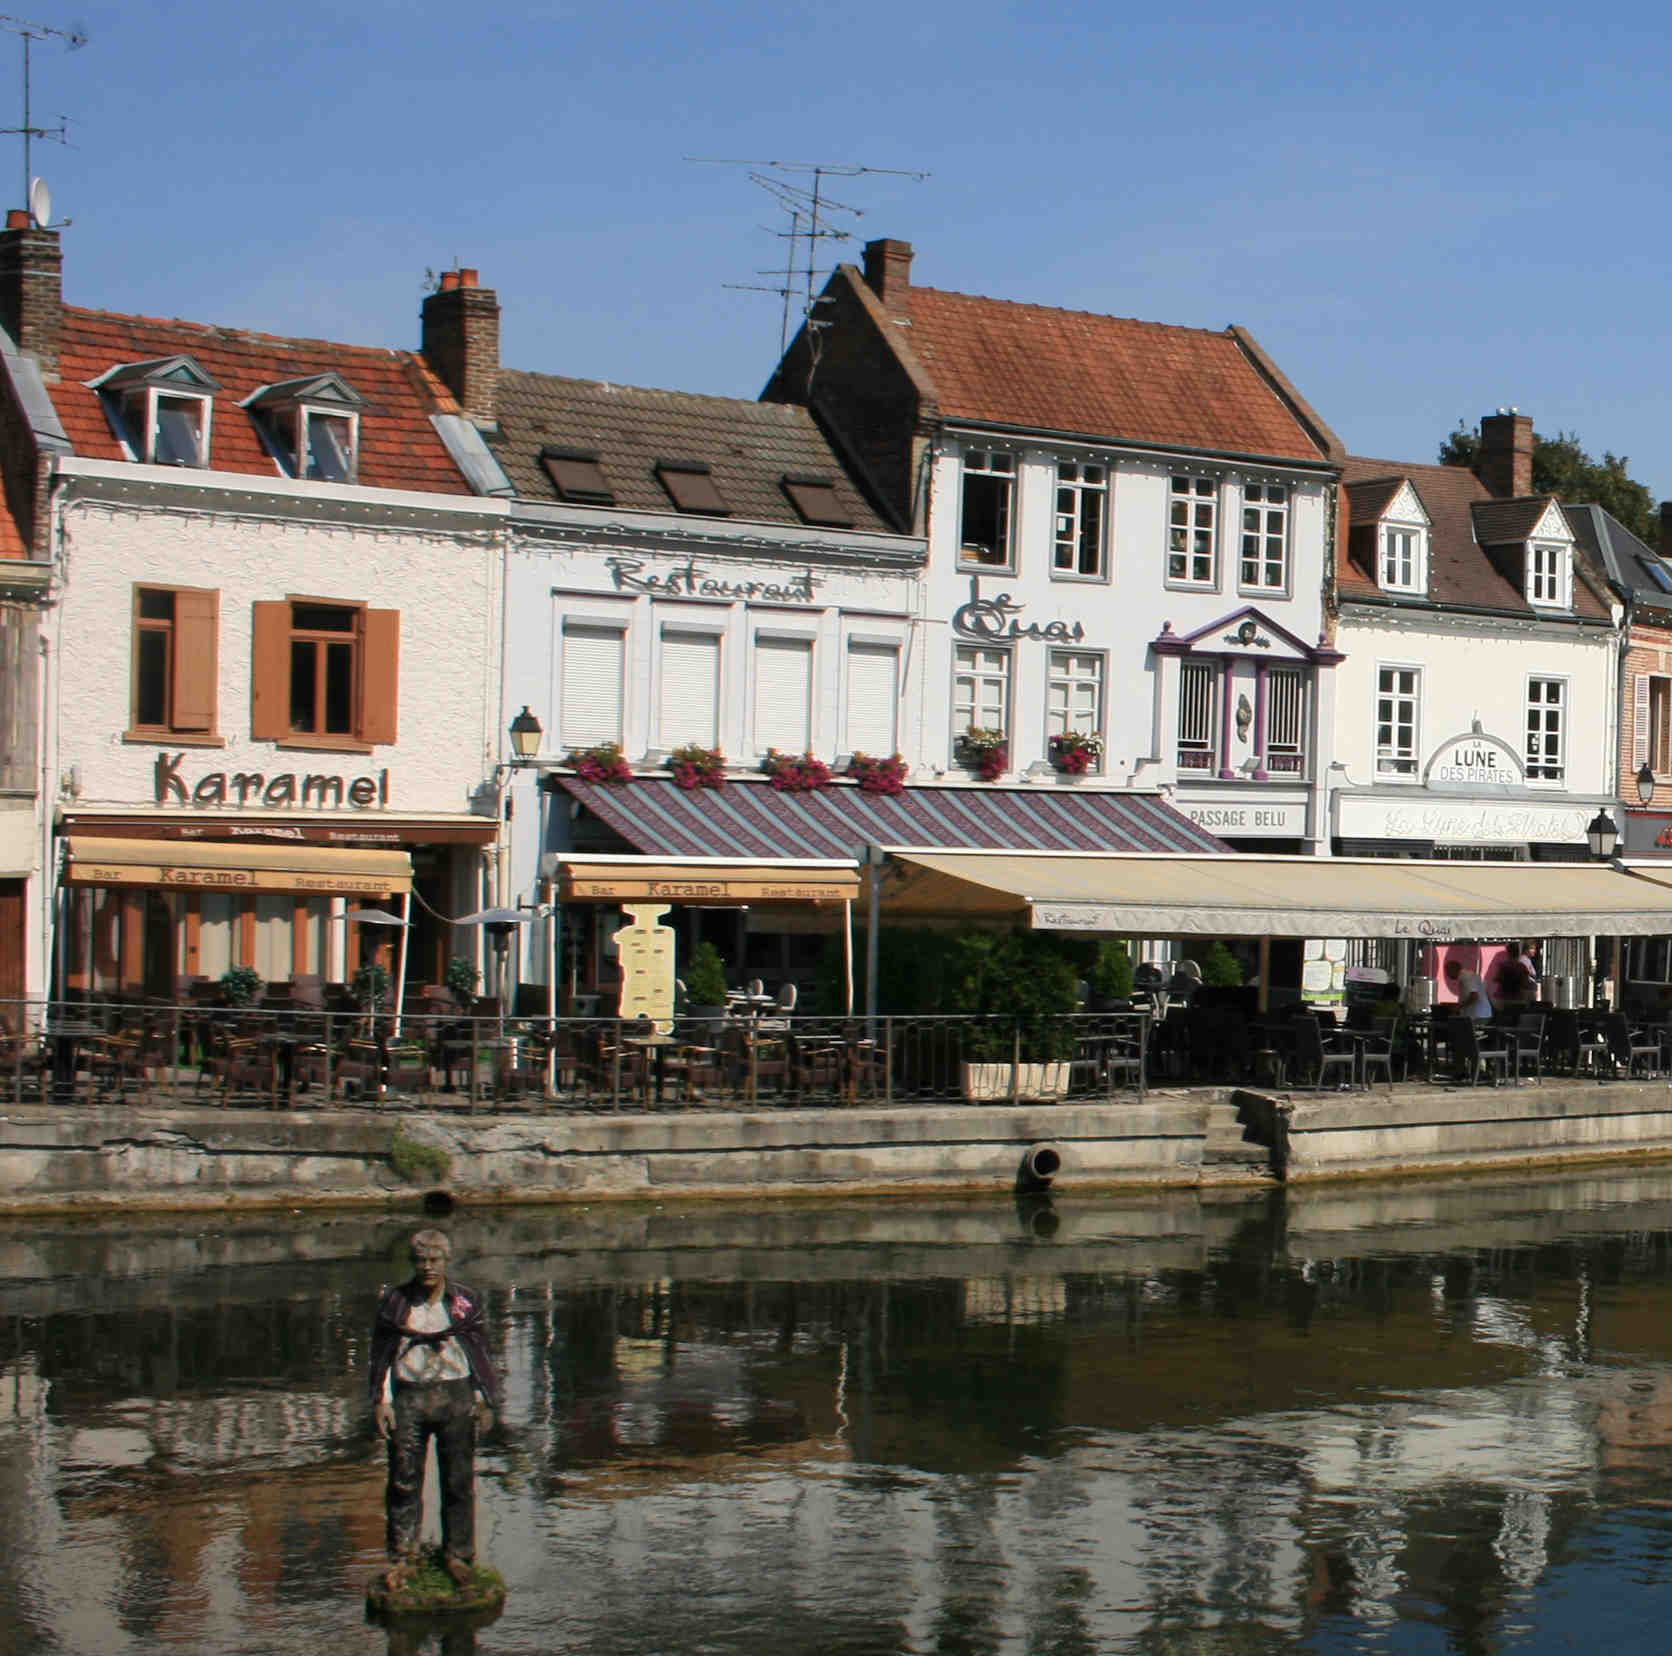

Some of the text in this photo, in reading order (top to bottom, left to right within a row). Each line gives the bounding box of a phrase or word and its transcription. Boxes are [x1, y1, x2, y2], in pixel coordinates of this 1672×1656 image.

[604, 556, 826, 602] Restaurant
[1455, 749, 1497, 768] LUNE
[155, 752, 389, 807] Karamel
[1440, 766, 1513, 784] DES PIRATES
[1190, 810, 1286, 826] PASSAGE BELU
[93, 868, 392, 891] Bar Karamel Restaurant
[591, 881, 842, 898] Bar Karamel Restaurant
[1395, 919, 1451, 936] Le Quai
